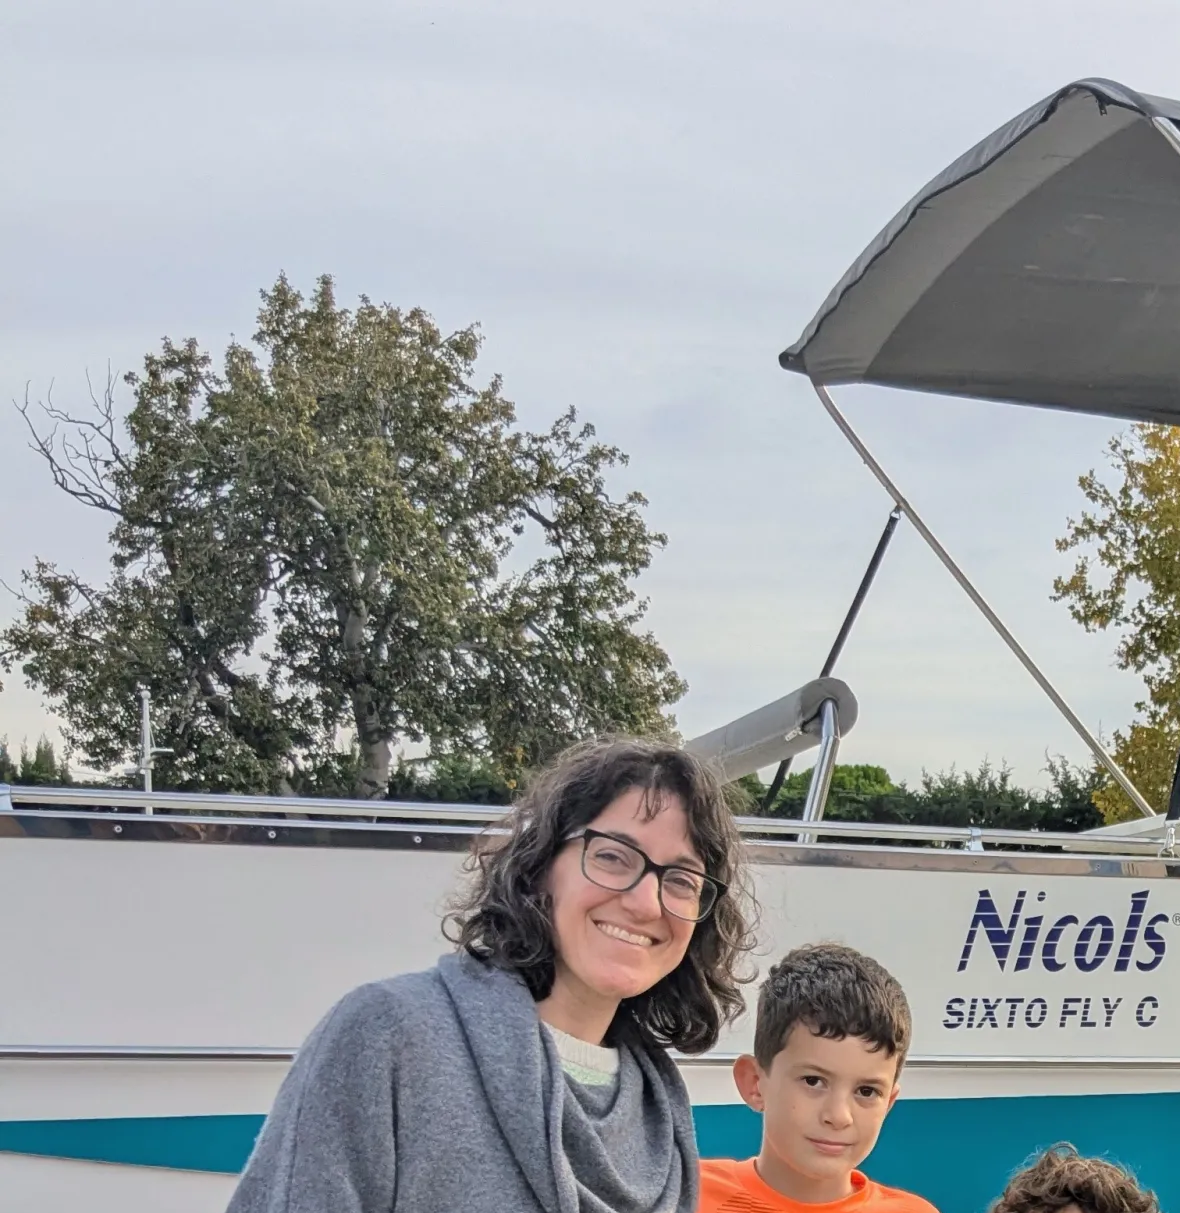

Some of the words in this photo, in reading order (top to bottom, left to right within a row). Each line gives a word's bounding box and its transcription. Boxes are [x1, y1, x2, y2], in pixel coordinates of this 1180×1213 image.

[942, 997, 1048, 1029] SIXTO
[1059, 997, 1123, 1028] FLY
[1135, 996, 1159, 1028] C
